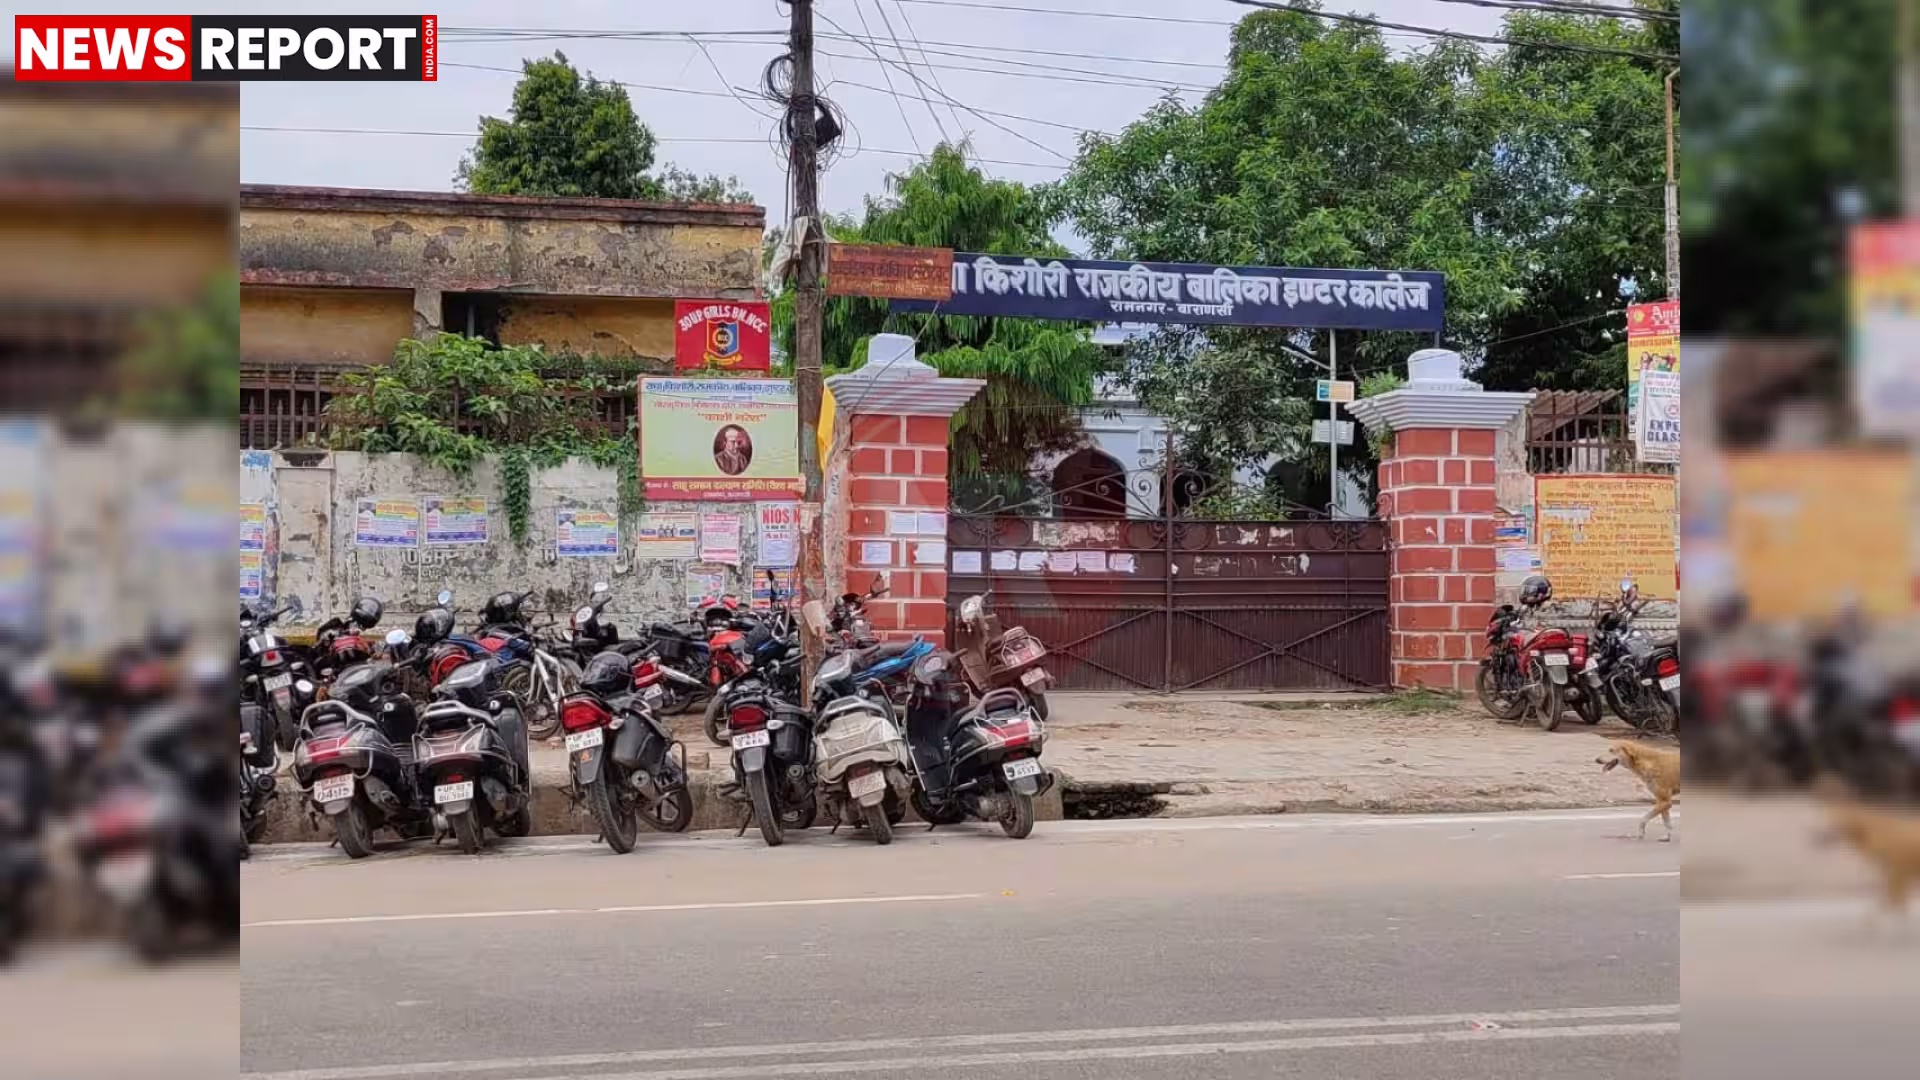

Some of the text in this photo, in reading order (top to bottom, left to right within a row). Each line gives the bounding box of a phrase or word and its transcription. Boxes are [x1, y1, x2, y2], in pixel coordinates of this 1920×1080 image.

[973, 256, 1070, 298] किशोरी
[1072, 264, 1185, 301] राजकीय
[1184, 268, 1281, 306] बालिका
[1282, 277, 1349, 308] इण्टर
[1349, 273, 1432, 311] कालेज
[703, 305, 731, 319] GIRLS
